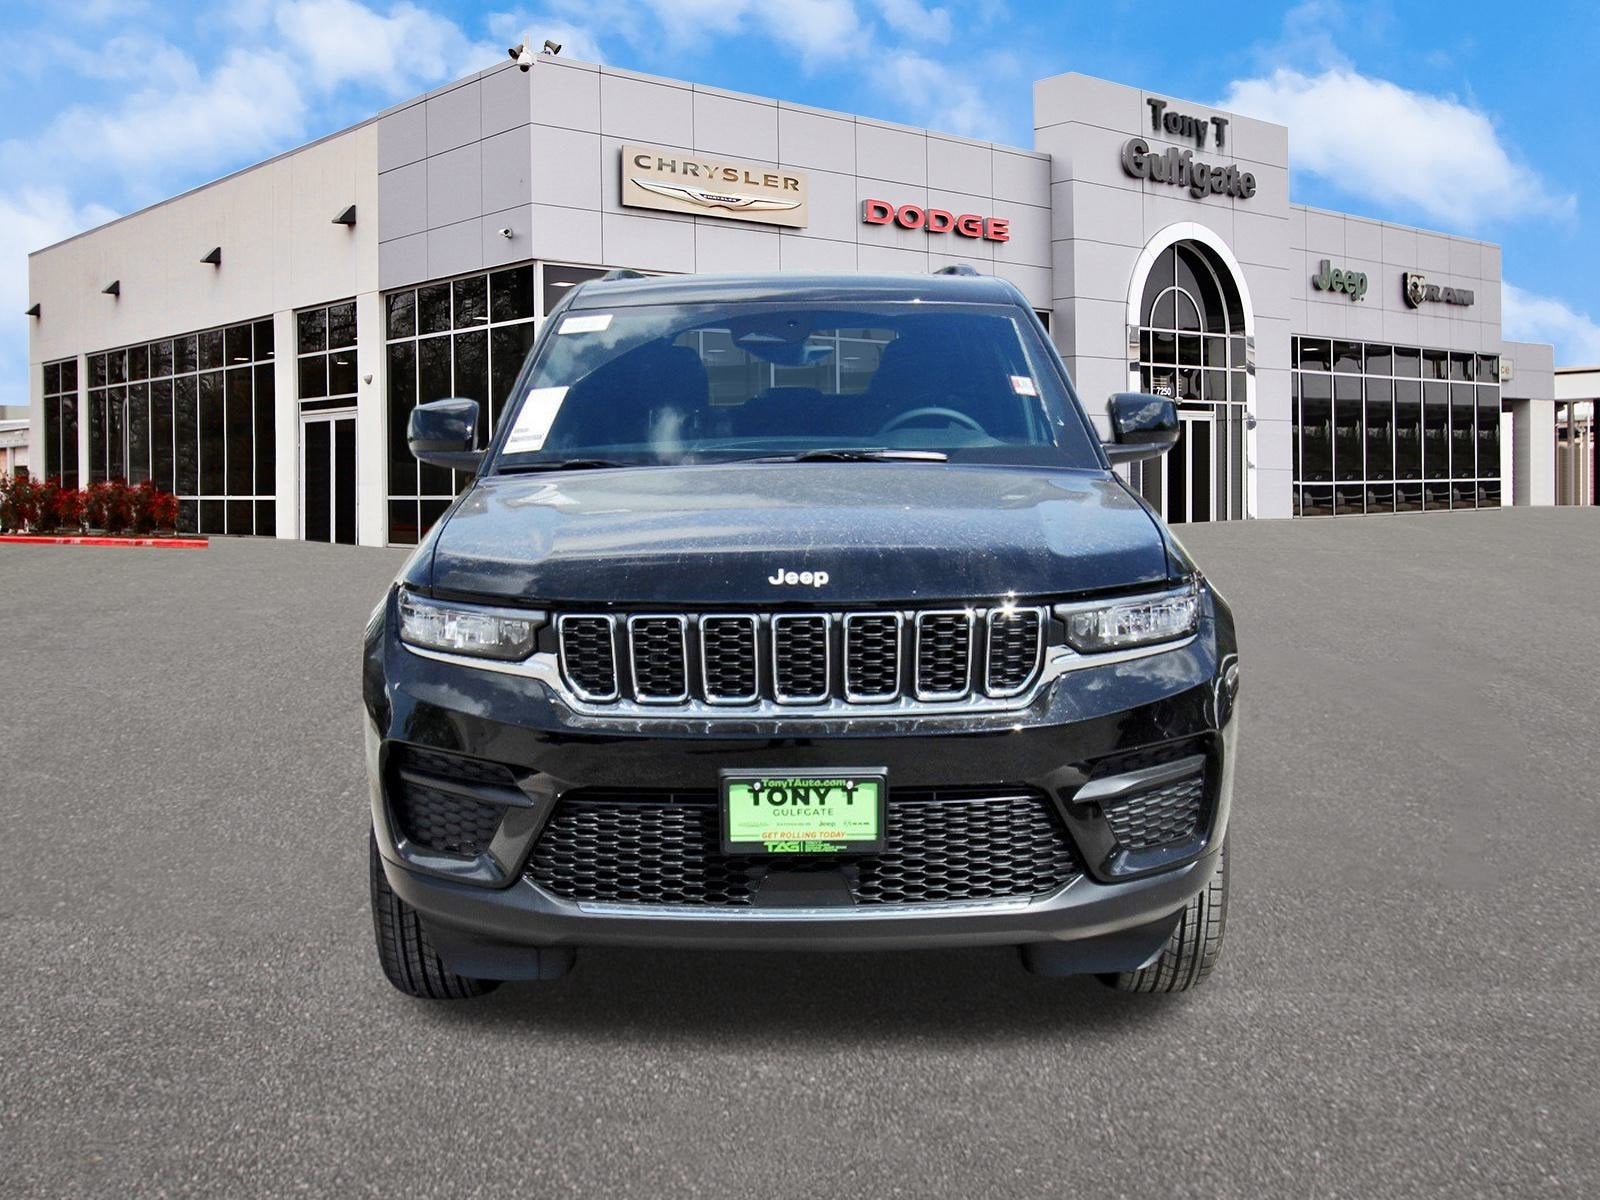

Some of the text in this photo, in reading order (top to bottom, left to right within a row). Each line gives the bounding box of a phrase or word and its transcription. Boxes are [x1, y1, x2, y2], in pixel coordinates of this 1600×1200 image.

[1146, 98, 1229, 148] Tony T
[633, 154, 800, 192] CHRYSLER
[1120, 138, 1256, 199] Gulfgate
[863, 198, 1010, 243] DODGE
[1312, 259, 1367, 301] Jeep
[1425, 283, 1475, 307] RAM
[768, 567, 829, 588] Jeep
[761, 776, 846, 788] TonyTAuto.com
[747, 784, 859, 806] TONY T
[772, 807, 835, 817] GULFGATE
[761, 831, 845, 840] GET ROLLING TODAY
